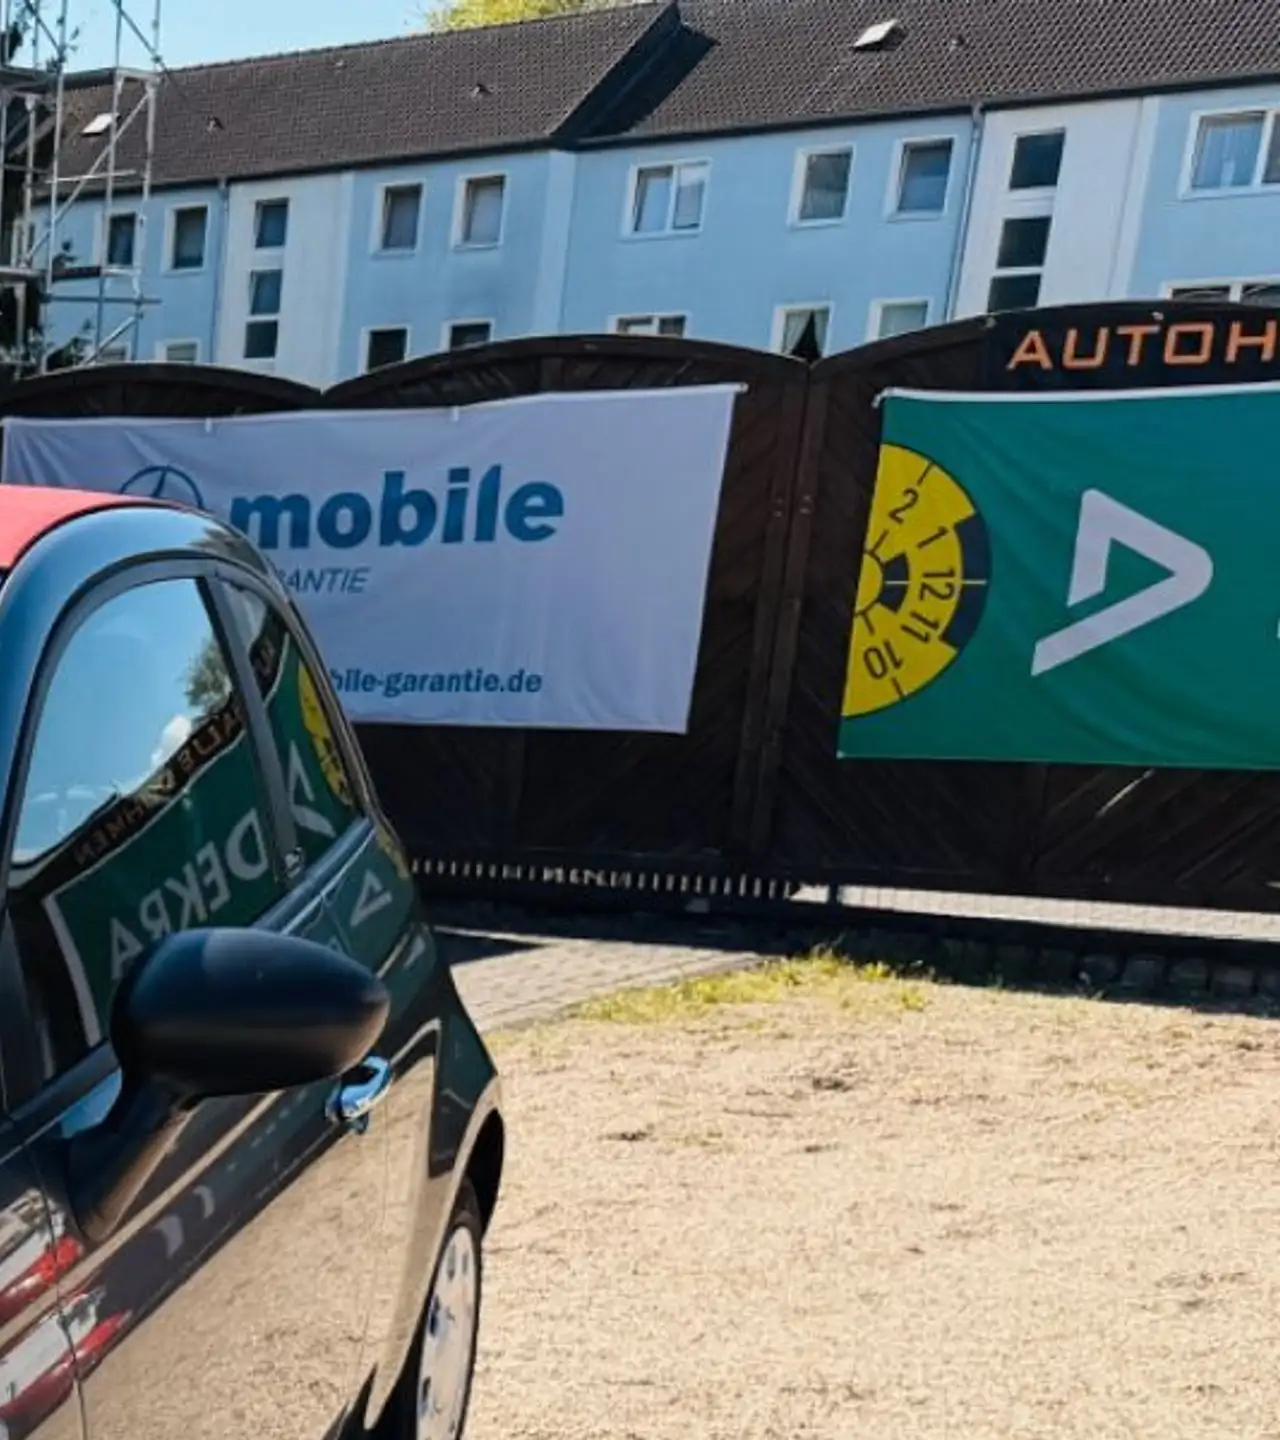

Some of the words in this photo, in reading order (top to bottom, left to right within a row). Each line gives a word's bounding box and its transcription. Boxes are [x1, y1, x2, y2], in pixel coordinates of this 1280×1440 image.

[230, 465, 565, 549] mobile
[888, 487, 919, 525] 2
[918, 567, 957, 601] 12
[861, 639, 905, 681] 10
